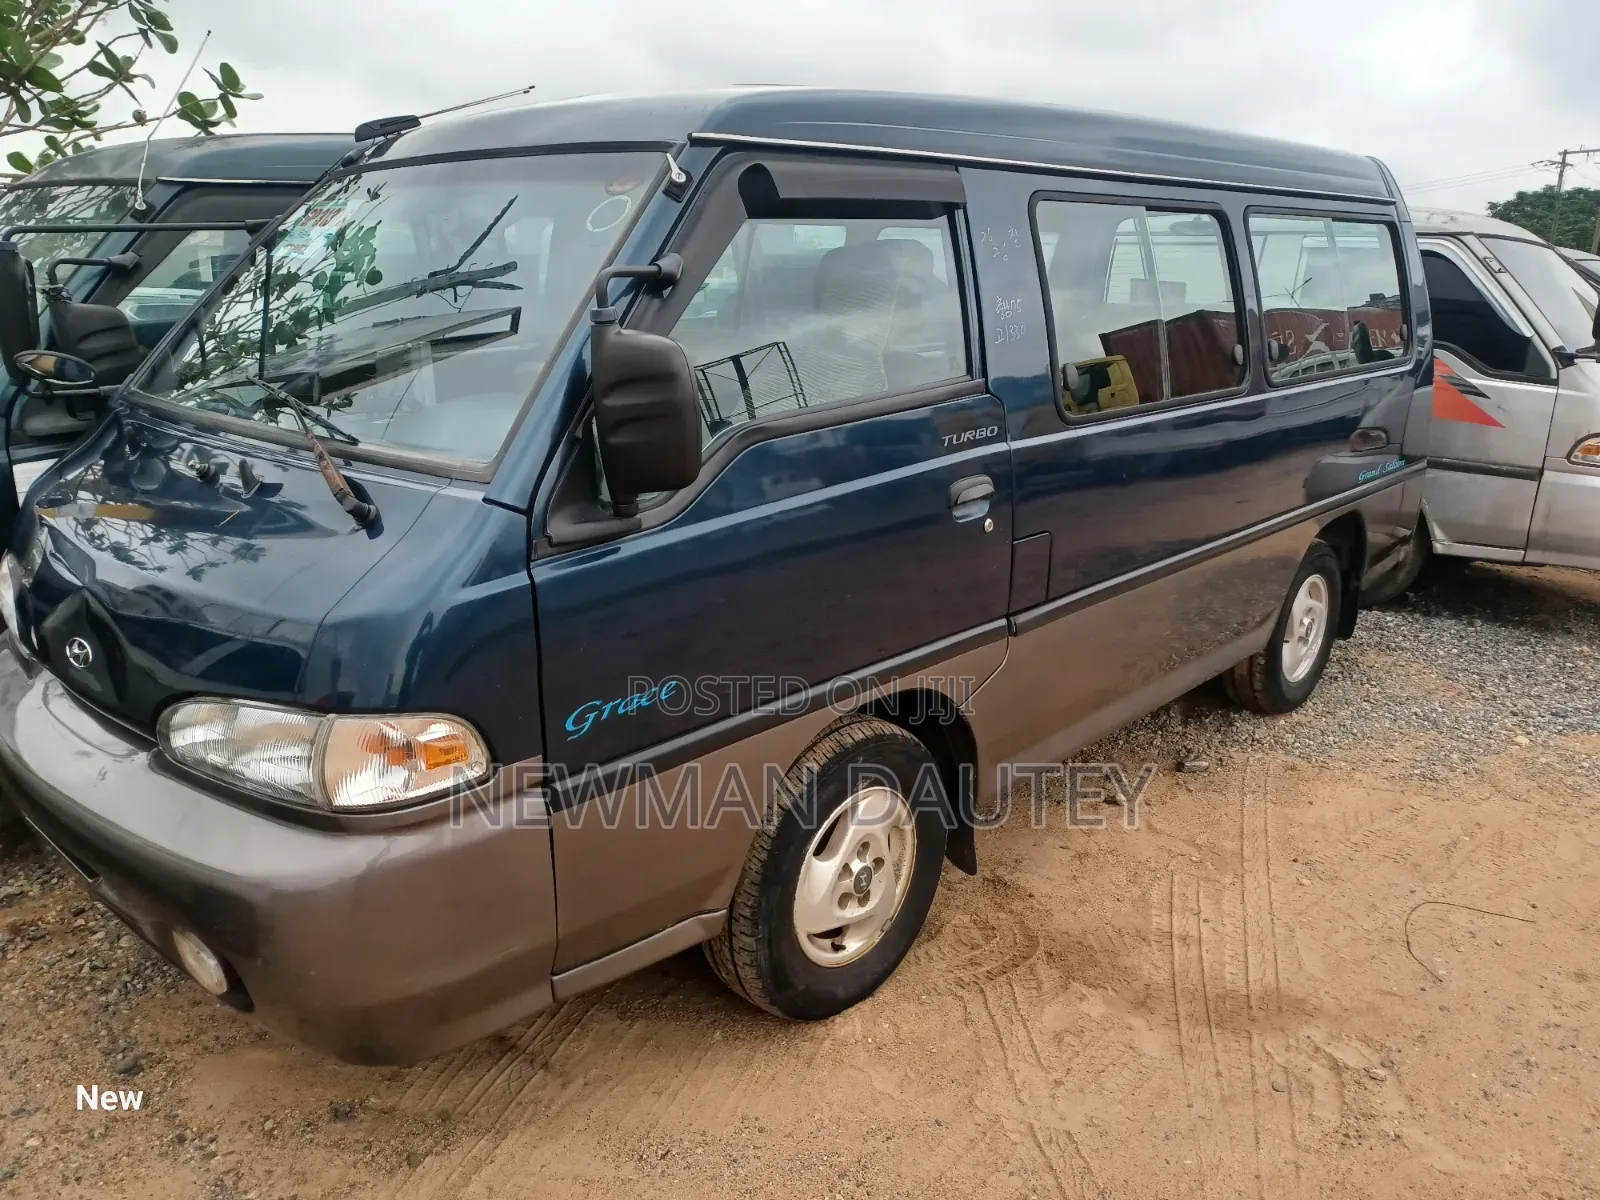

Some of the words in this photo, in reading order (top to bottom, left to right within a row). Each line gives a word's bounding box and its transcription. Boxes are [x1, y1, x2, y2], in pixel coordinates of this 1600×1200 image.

[942, 425, 998, 447] TURBO
[1358, 464, 1383, 483] Grand
[565, 680, 677, 742] Grace
